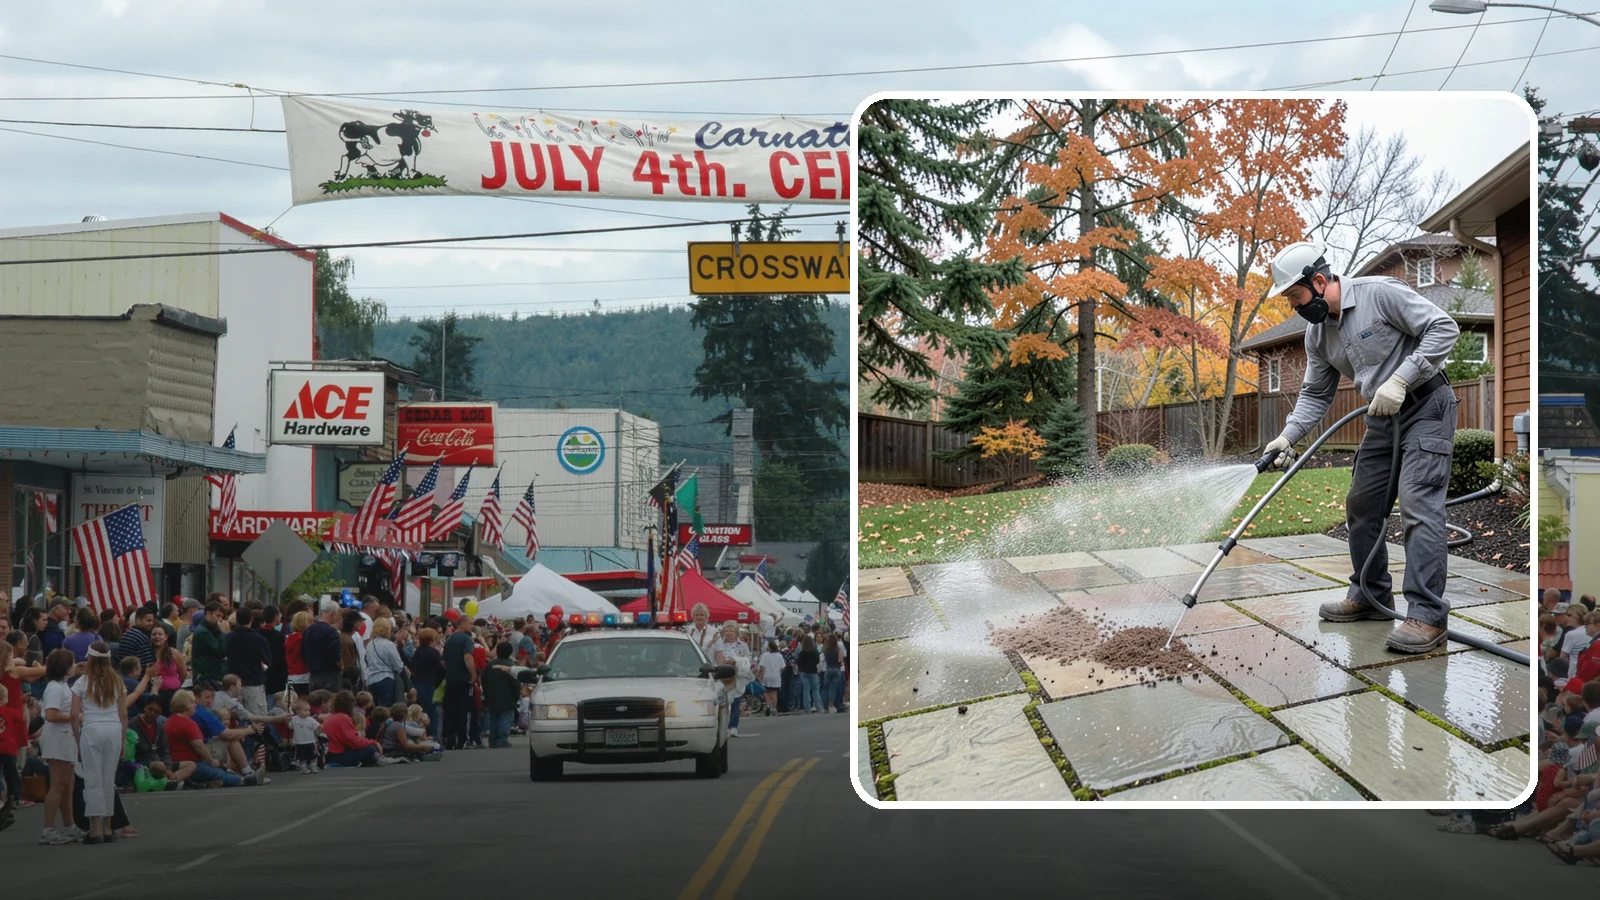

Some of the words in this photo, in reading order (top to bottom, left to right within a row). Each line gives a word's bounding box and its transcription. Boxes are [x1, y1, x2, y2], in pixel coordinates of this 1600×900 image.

[481, 141, 604, 192] JULY
[632, 150, 746, 197] 4th.
[697, 254, 850, 280] CROSSWA
[282, 380, 373, 420] ACE
[405, 409, 452, 422] CEDAR
[461, 409, 485, 421] LOG
[283, 421, 370, 436] Hardware
[83, 485, 93, 494] St.
[95, 485, 124, 494] Vincent
[126, 486, 136, 494] de
[138, 486, 155, 495] Paul
[688, 526, 741, 535] CRNATION
[699, 535, 730, 543] GLASS
